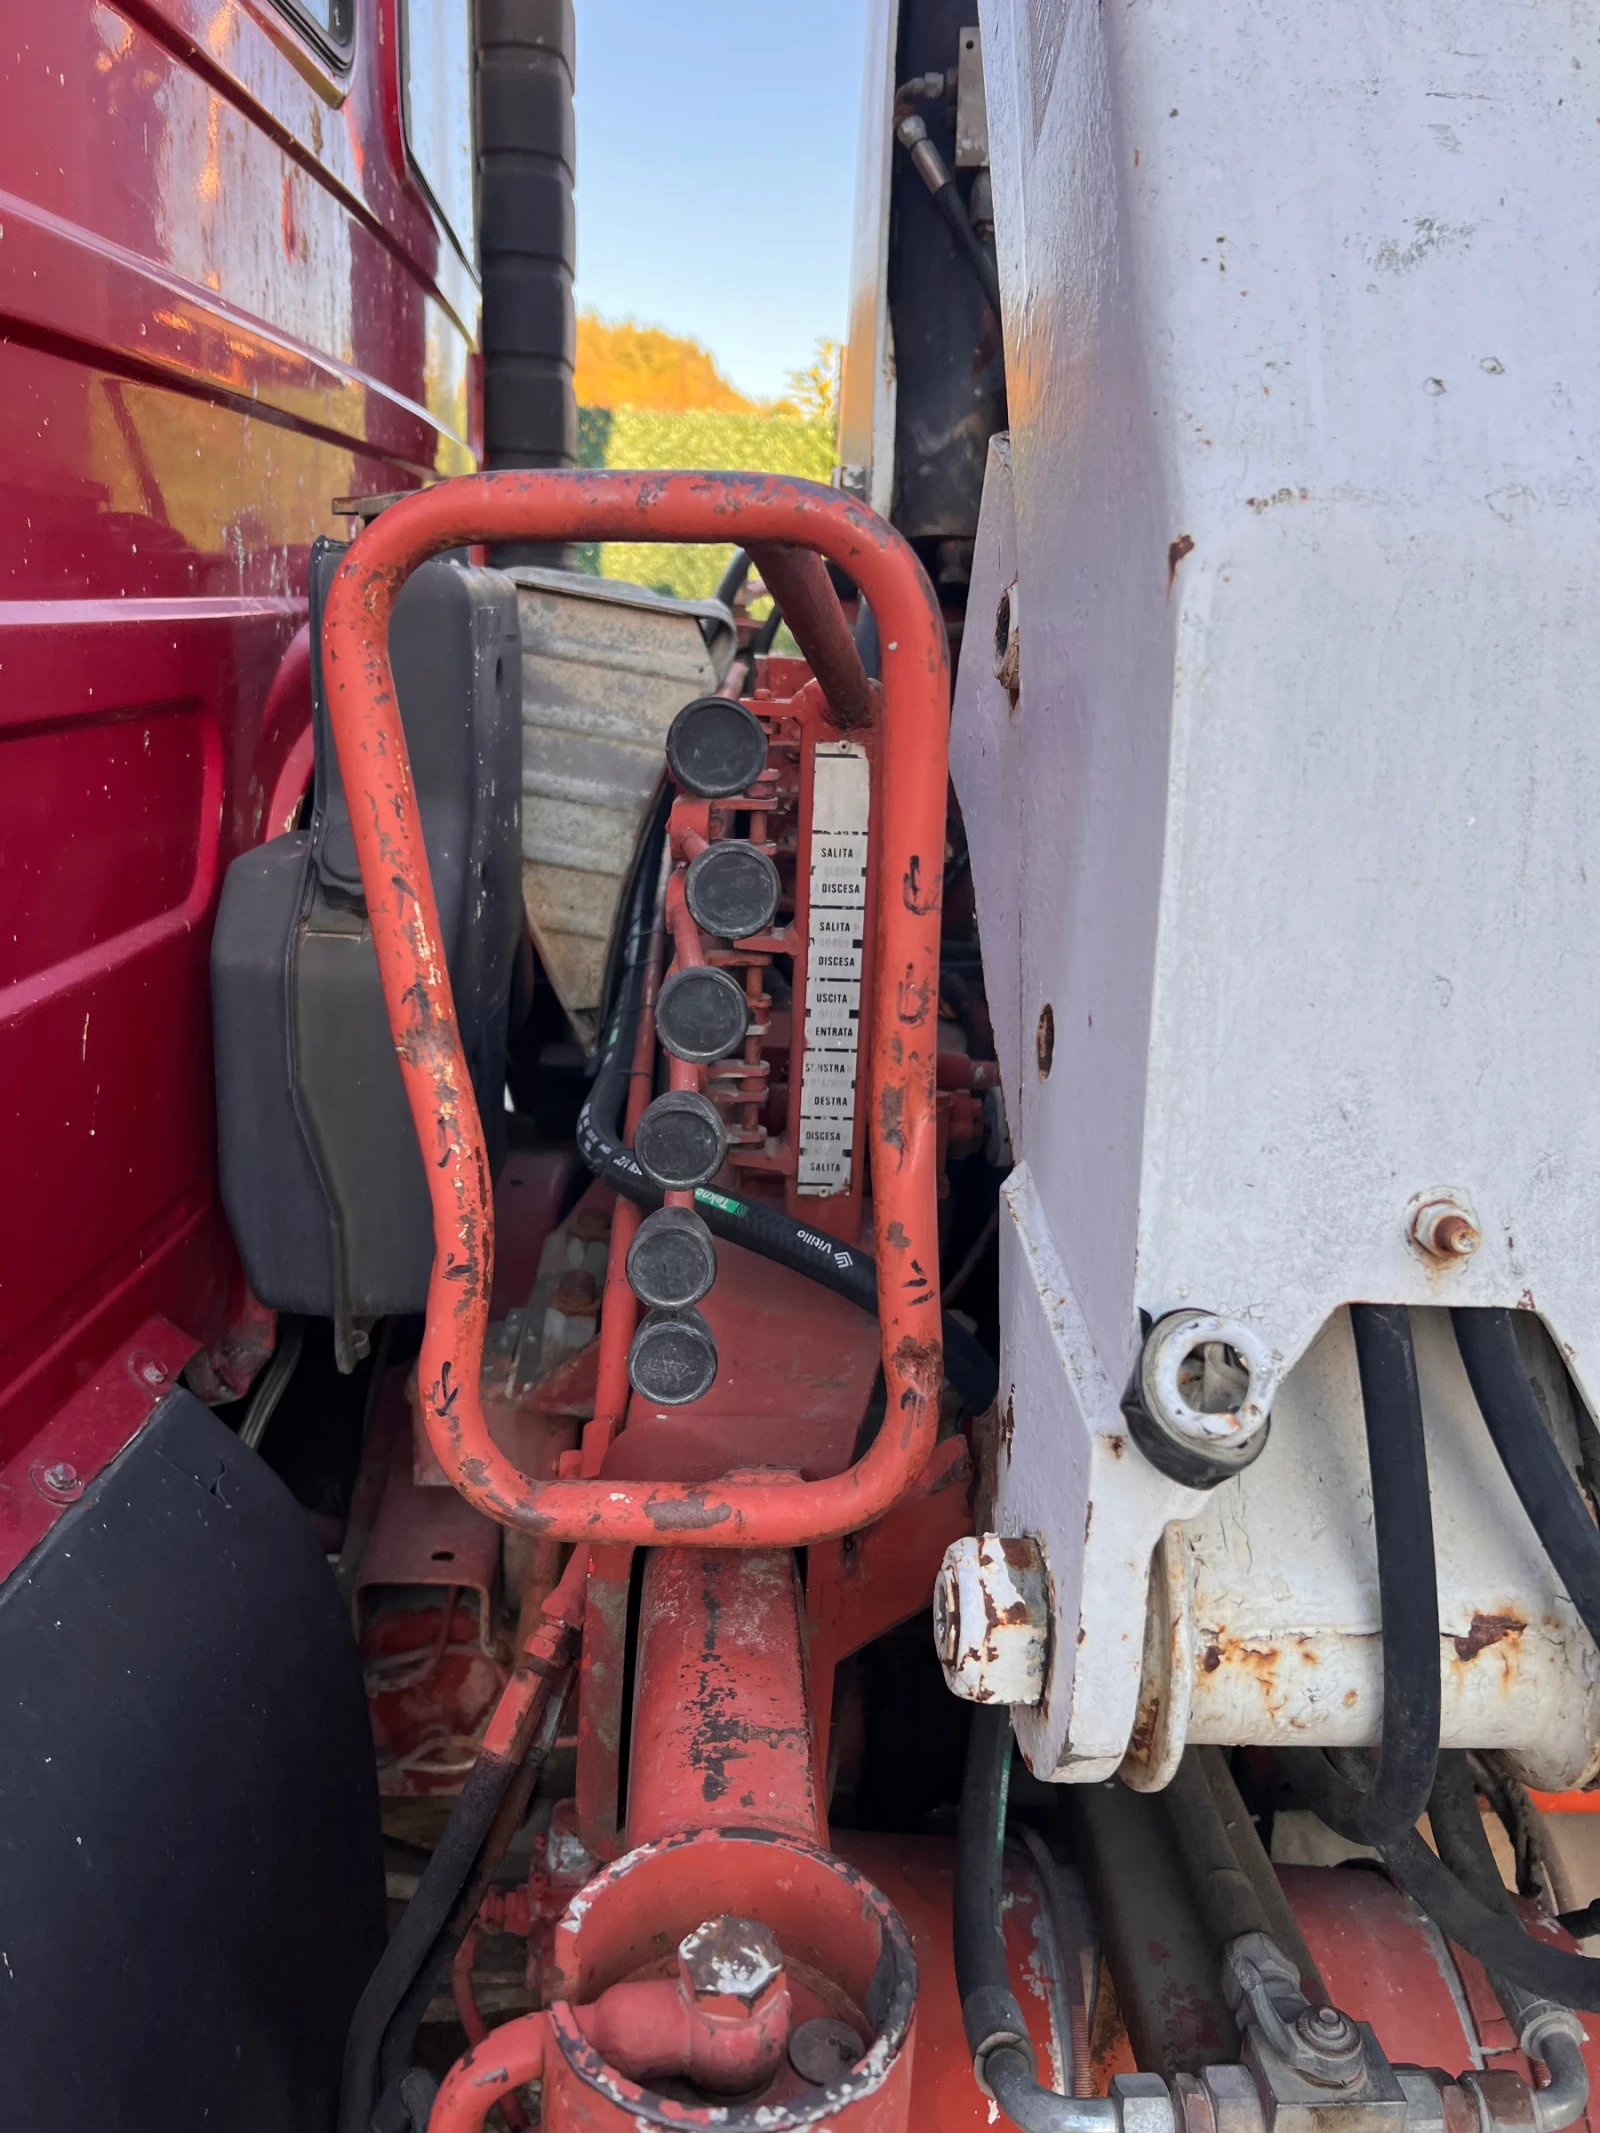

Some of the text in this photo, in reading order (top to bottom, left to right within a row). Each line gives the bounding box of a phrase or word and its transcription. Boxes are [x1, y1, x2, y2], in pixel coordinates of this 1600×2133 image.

[821, 847, 853, 858] SALITA
[822, 883, 860, 894] DISCESA
[819, 921, 850, 932] SALITA
[818, 956, 855, 967] DISCESA
[816, 993, 847, 1004] USCITA
[815, 1026, 853, 1037] ENTRATA
[814, 1096, 848, 1106] DESTRA
[805, 1131, 841, 1141] DISCESA
[810, 1162, 840, 1172] SALITA
[695, 1188, 729, 1209] Tekno
[797, 1229, 832, 1254] Vitillo
